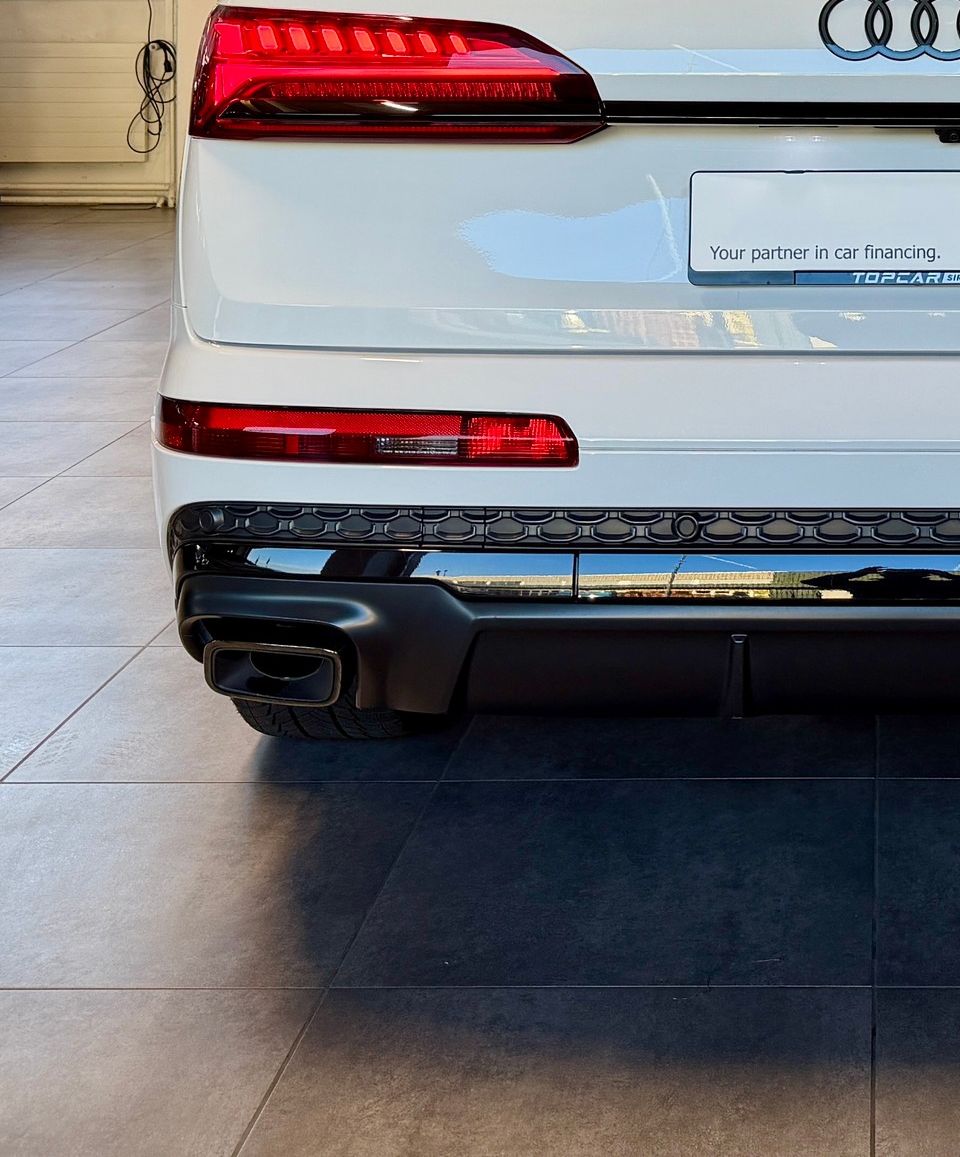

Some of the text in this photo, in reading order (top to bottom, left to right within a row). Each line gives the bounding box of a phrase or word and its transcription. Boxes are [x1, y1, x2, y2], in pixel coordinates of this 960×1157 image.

[709, 244, 941, 263] Your partner in car financing.
[852, 272, 941, 284] TOPCAR
